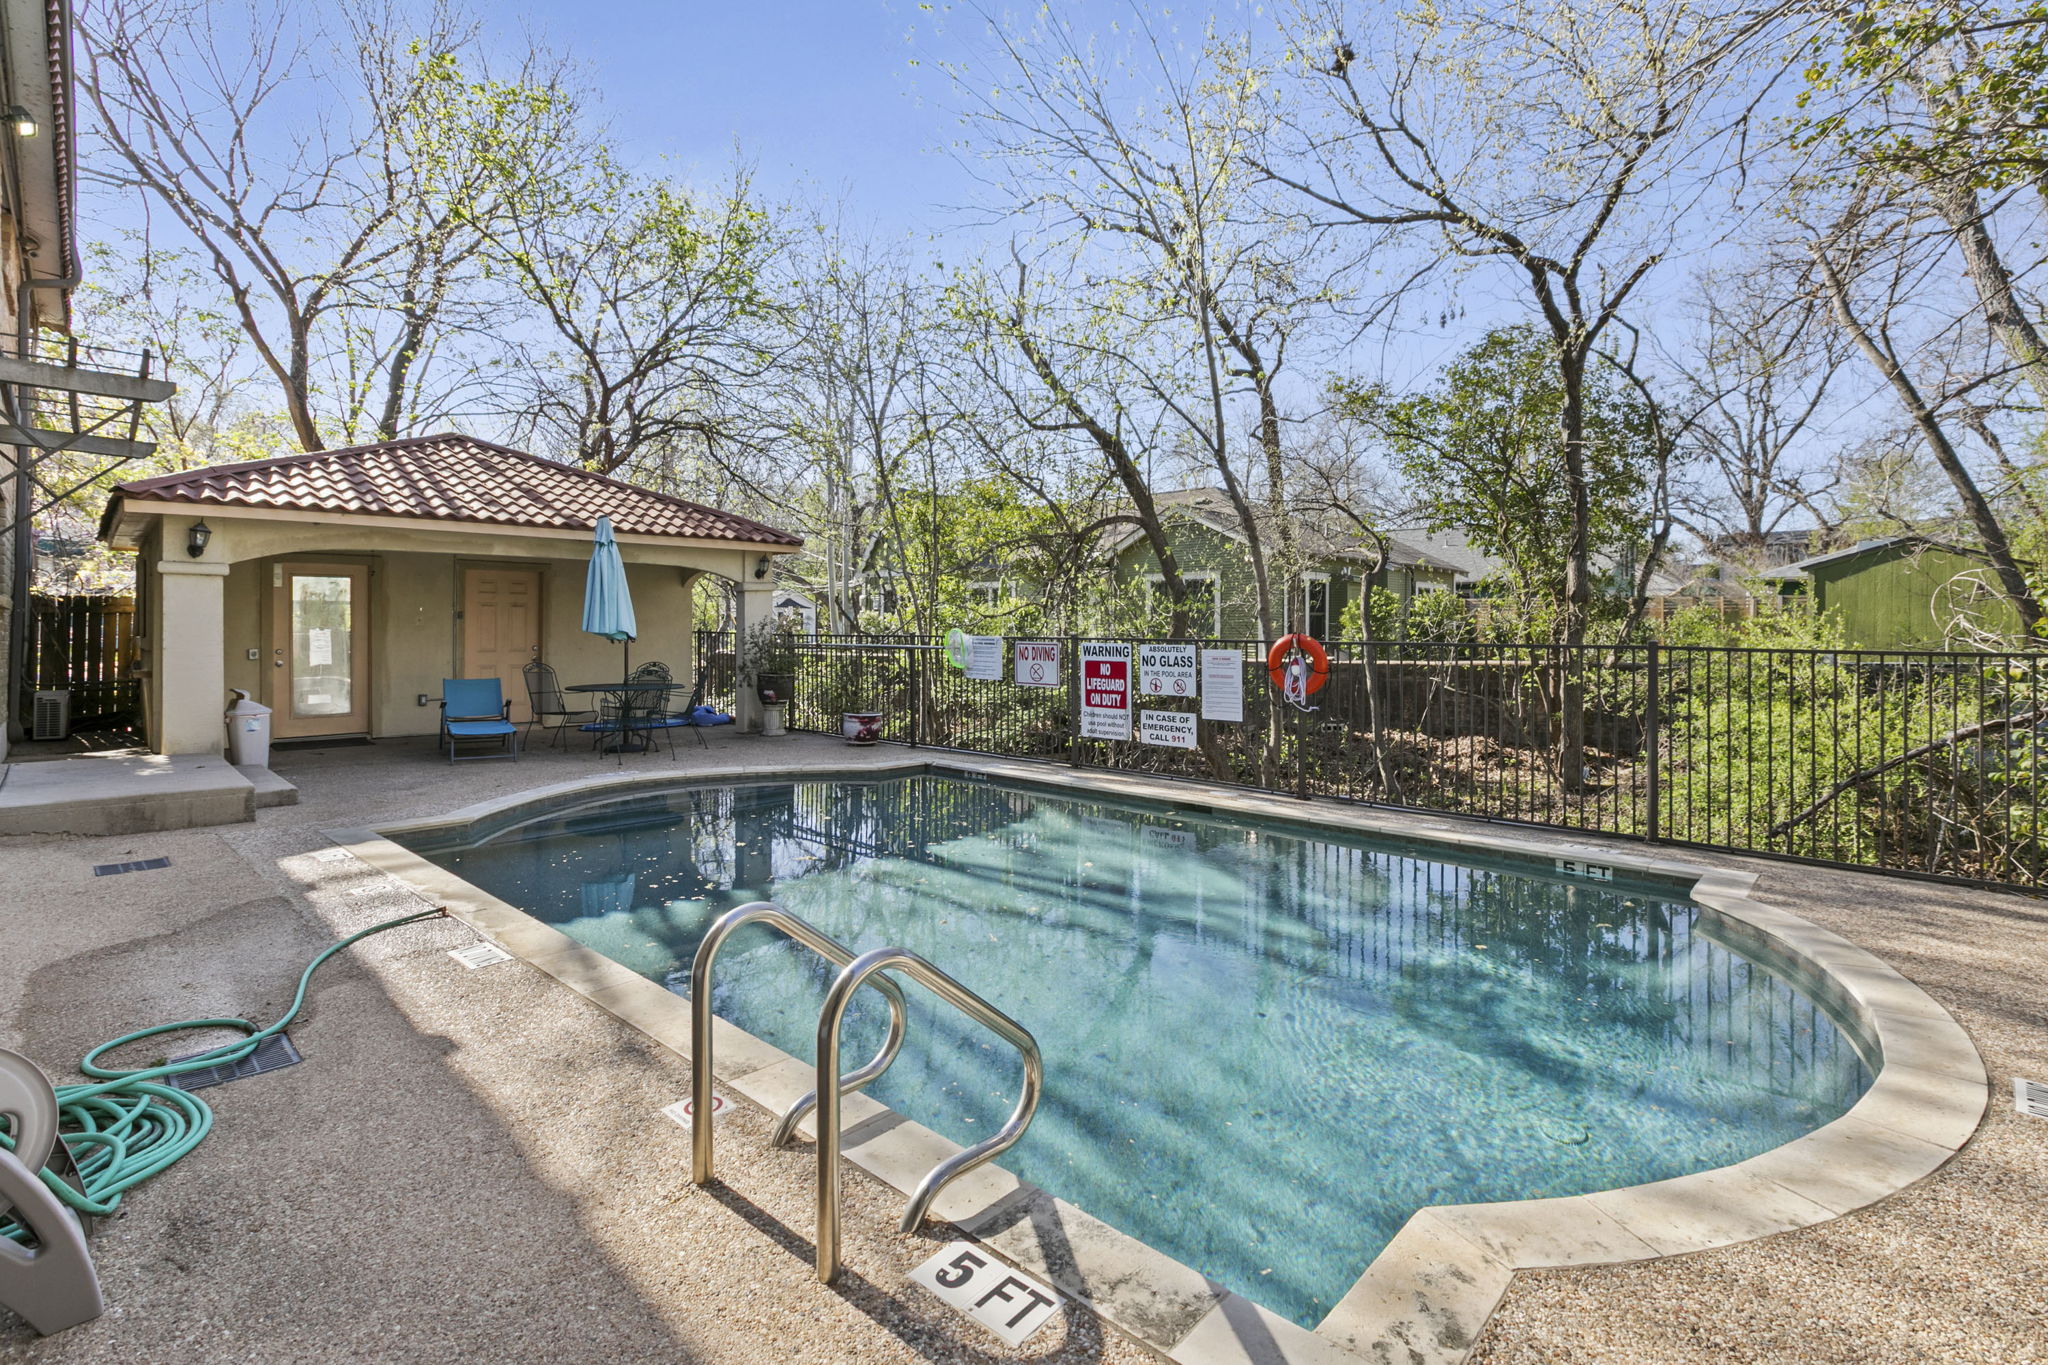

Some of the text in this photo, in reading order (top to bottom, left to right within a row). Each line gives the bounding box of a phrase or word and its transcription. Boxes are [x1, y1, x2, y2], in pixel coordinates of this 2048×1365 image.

[1019, 646, 1055, 662] NO DIVING
[1083, 645, 1130, 657] WARNING
[1142, 655, 1156, 667] NO
[1159, 655, 1193, 668] GLASS
[1100, 663, 1111, 676] NO
[1087, 677, 1125, 692] LIFEGUARD
[1090, 693, 1121, 707] ON DUTY
[1083, 710, 1102, 718] Children
[1103, 712, 1118, 720] should
[1156, 714, 1177, 723] CASE
[1179, 716, 1190, 724] OF
[1142, 723, 1194, 736] EMERGENCY,
[1149, 733, 1185, 743] CALL 911
[1563, 860, 1610, 878] 5 FT
[935, 1250, 1056, 1329] 5 FT
